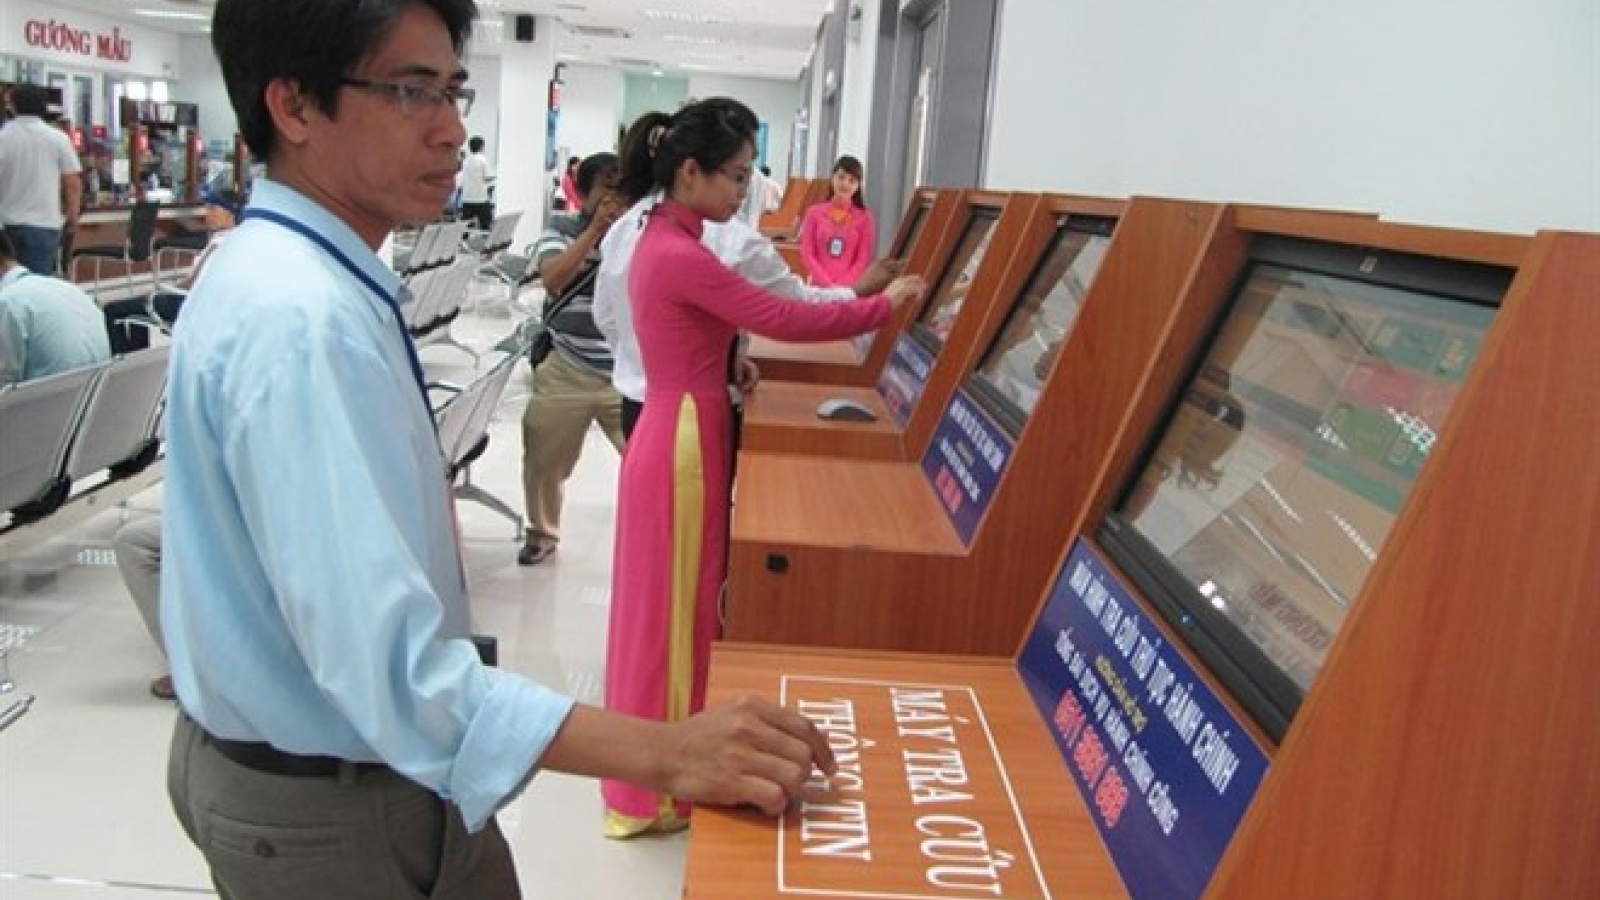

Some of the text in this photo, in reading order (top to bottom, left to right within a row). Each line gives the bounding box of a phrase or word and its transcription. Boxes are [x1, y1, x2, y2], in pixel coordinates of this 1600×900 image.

[890, 688, 1016, 895] MÁY TRA CỨU
[1100, 597, 1123, 637] TRA
[1130, 635, 1161, 680] THỦ
[1146, 658, 1176, 705] TỤC
[1163, 682, 1204, 746] HÀNH
[1192, 721, 1240, 795] CHÍNH
[800, 799, 872, 861] TIN
